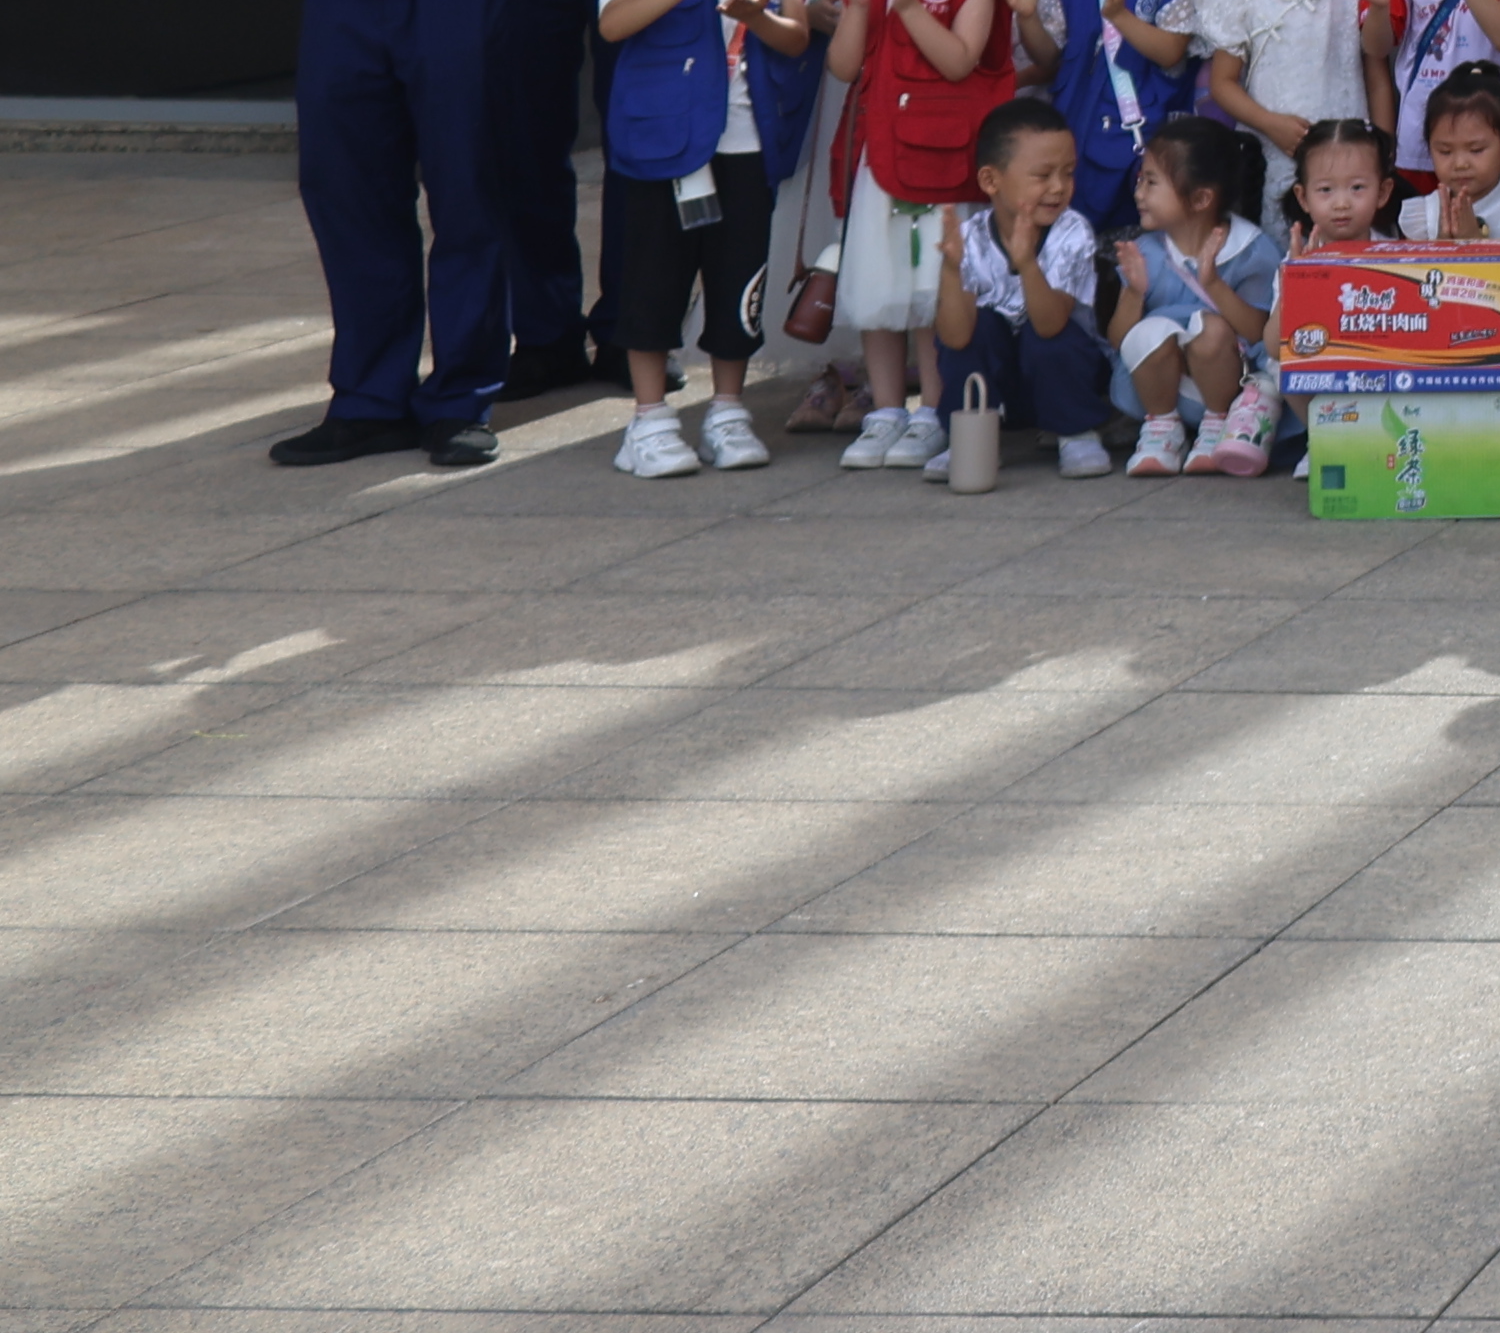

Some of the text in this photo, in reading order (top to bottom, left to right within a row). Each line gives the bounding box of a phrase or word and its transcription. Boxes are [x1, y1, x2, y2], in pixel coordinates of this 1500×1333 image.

[1354, 285, 1395, 310] 康师傅
[1340, 313, 1427, 332] 红烧牛肉面
[1294, 329, 1325, 346] 经典
[1396, 428, 1425, 484] 绿茶
